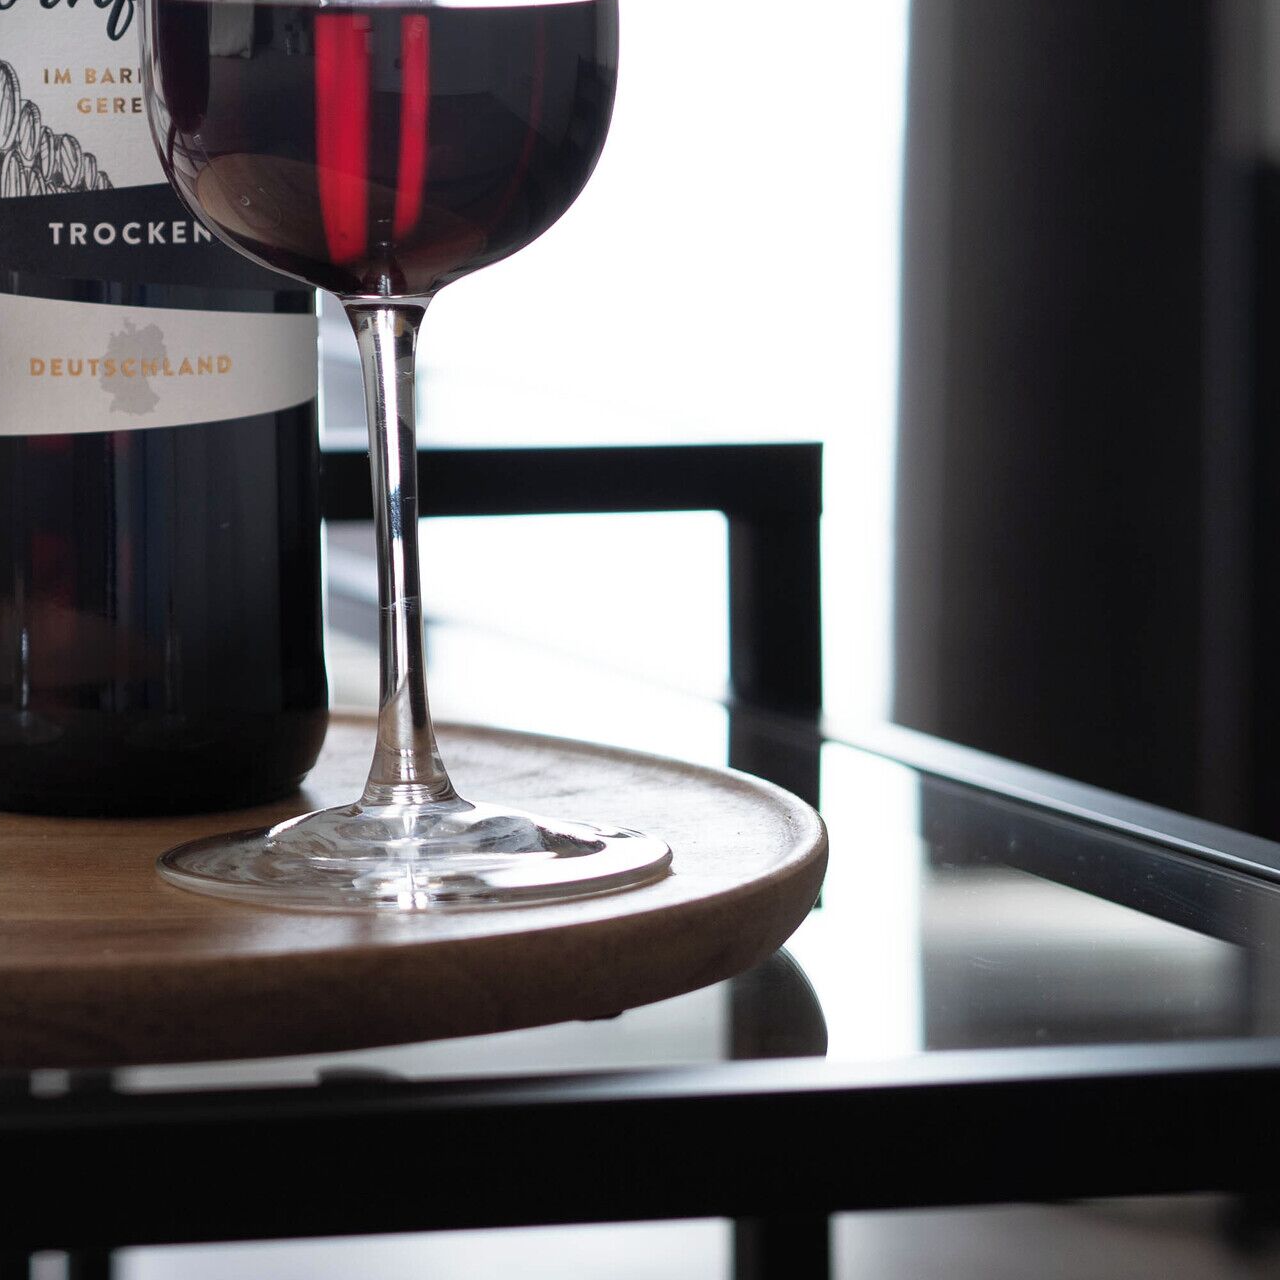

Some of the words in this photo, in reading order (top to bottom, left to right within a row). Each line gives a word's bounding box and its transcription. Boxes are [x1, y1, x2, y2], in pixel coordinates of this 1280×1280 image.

[43, 67, 72, 84] IM
[84, 67, 142, 84] BAR
[76, 96, 143, 114] GERE
[48, 221, 213, 245] TROCKEN
[29, 354, 233, 378] DEUTSCHLAND
